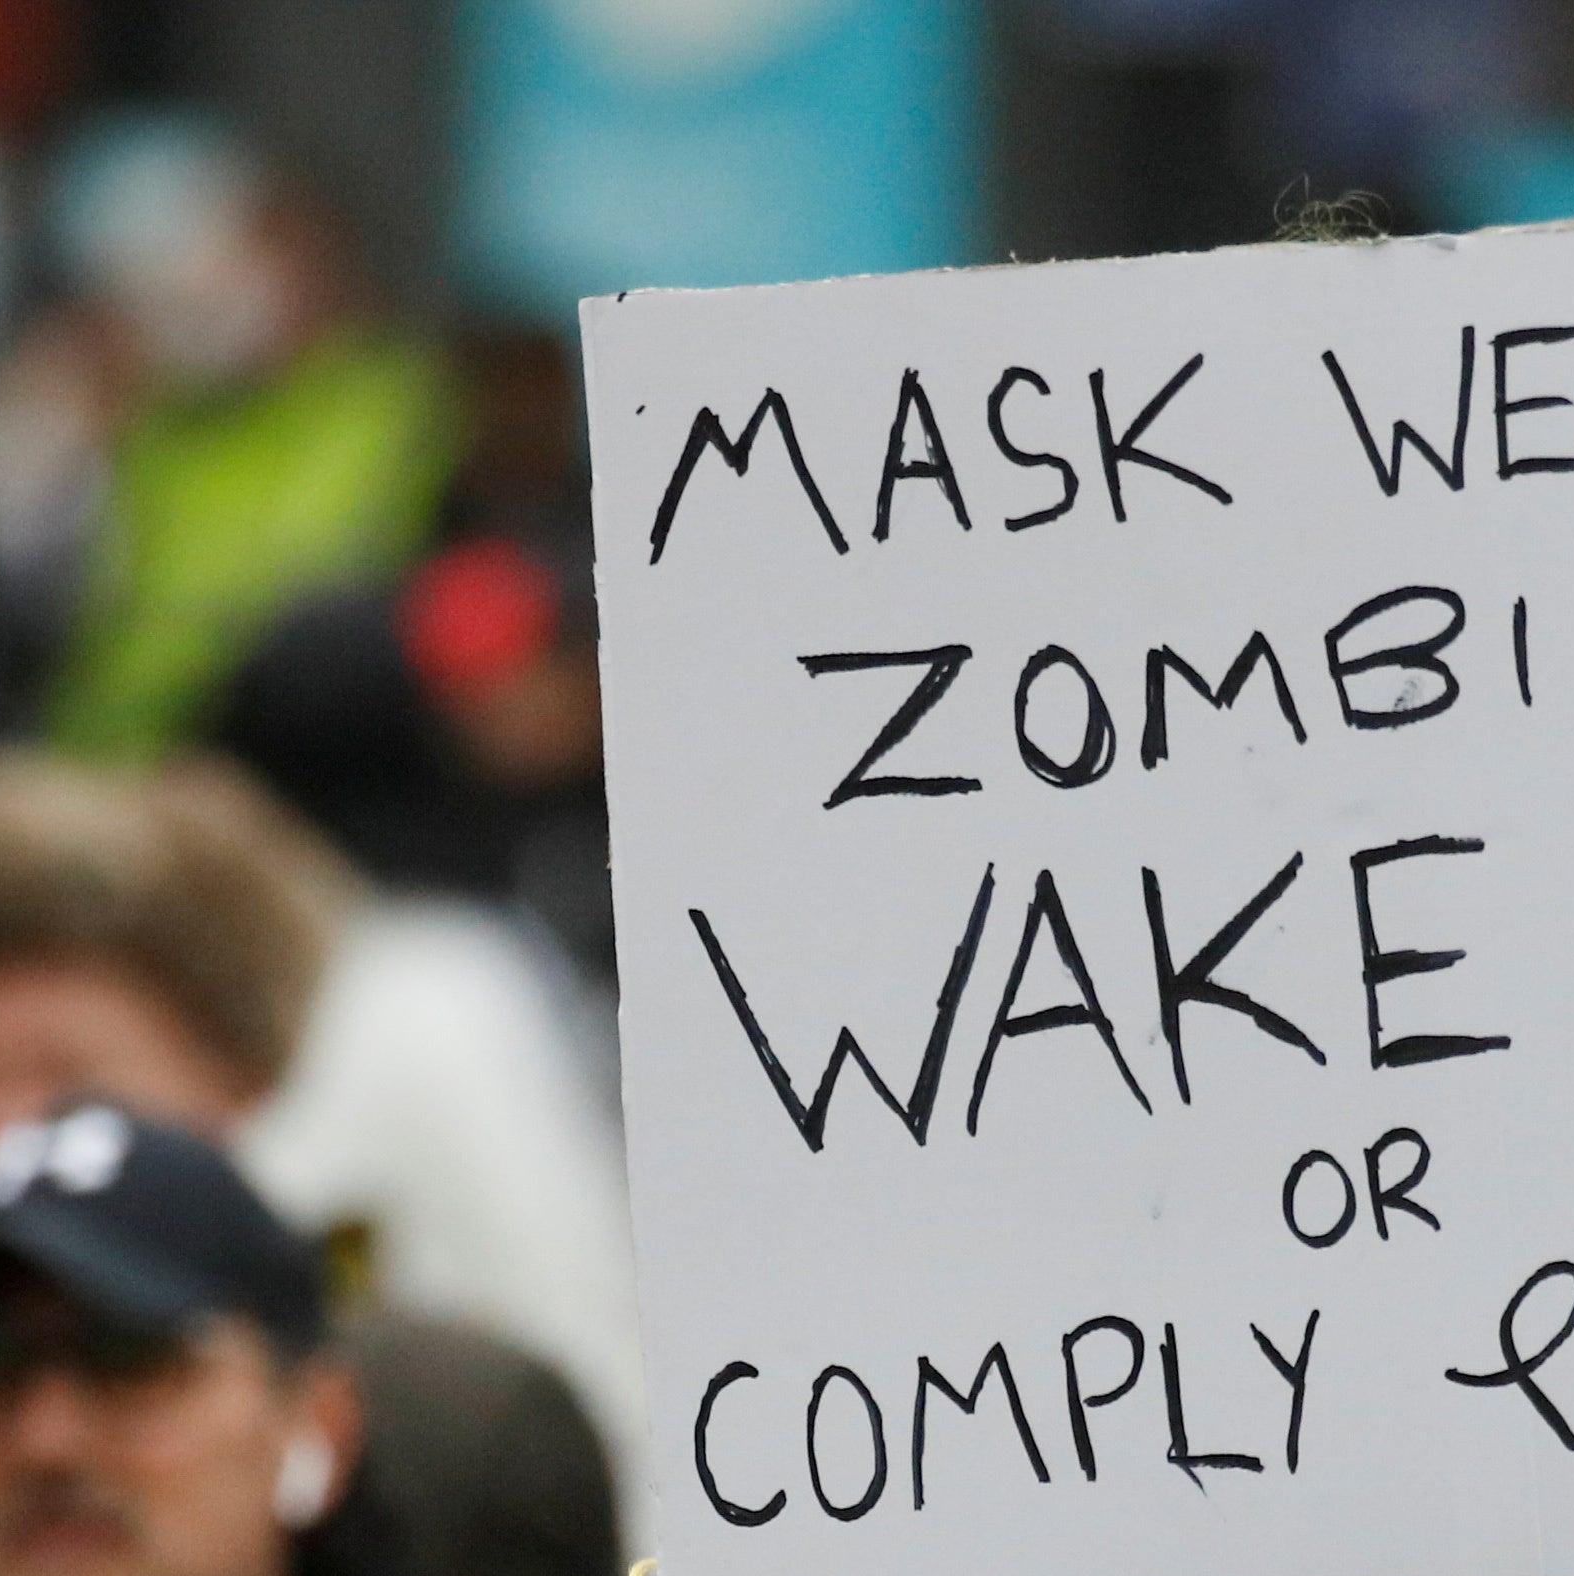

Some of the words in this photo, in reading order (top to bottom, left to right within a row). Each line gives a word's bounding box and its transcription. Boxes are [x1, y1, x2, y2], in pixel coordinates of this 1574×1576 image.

[648, 351, 1234, 567] MASK
[686, 833, 1513, 1154] WAKE
[1281, 1125, 1442, 1250] OR
[693, 1308, 1322, 1529] COMPLY
